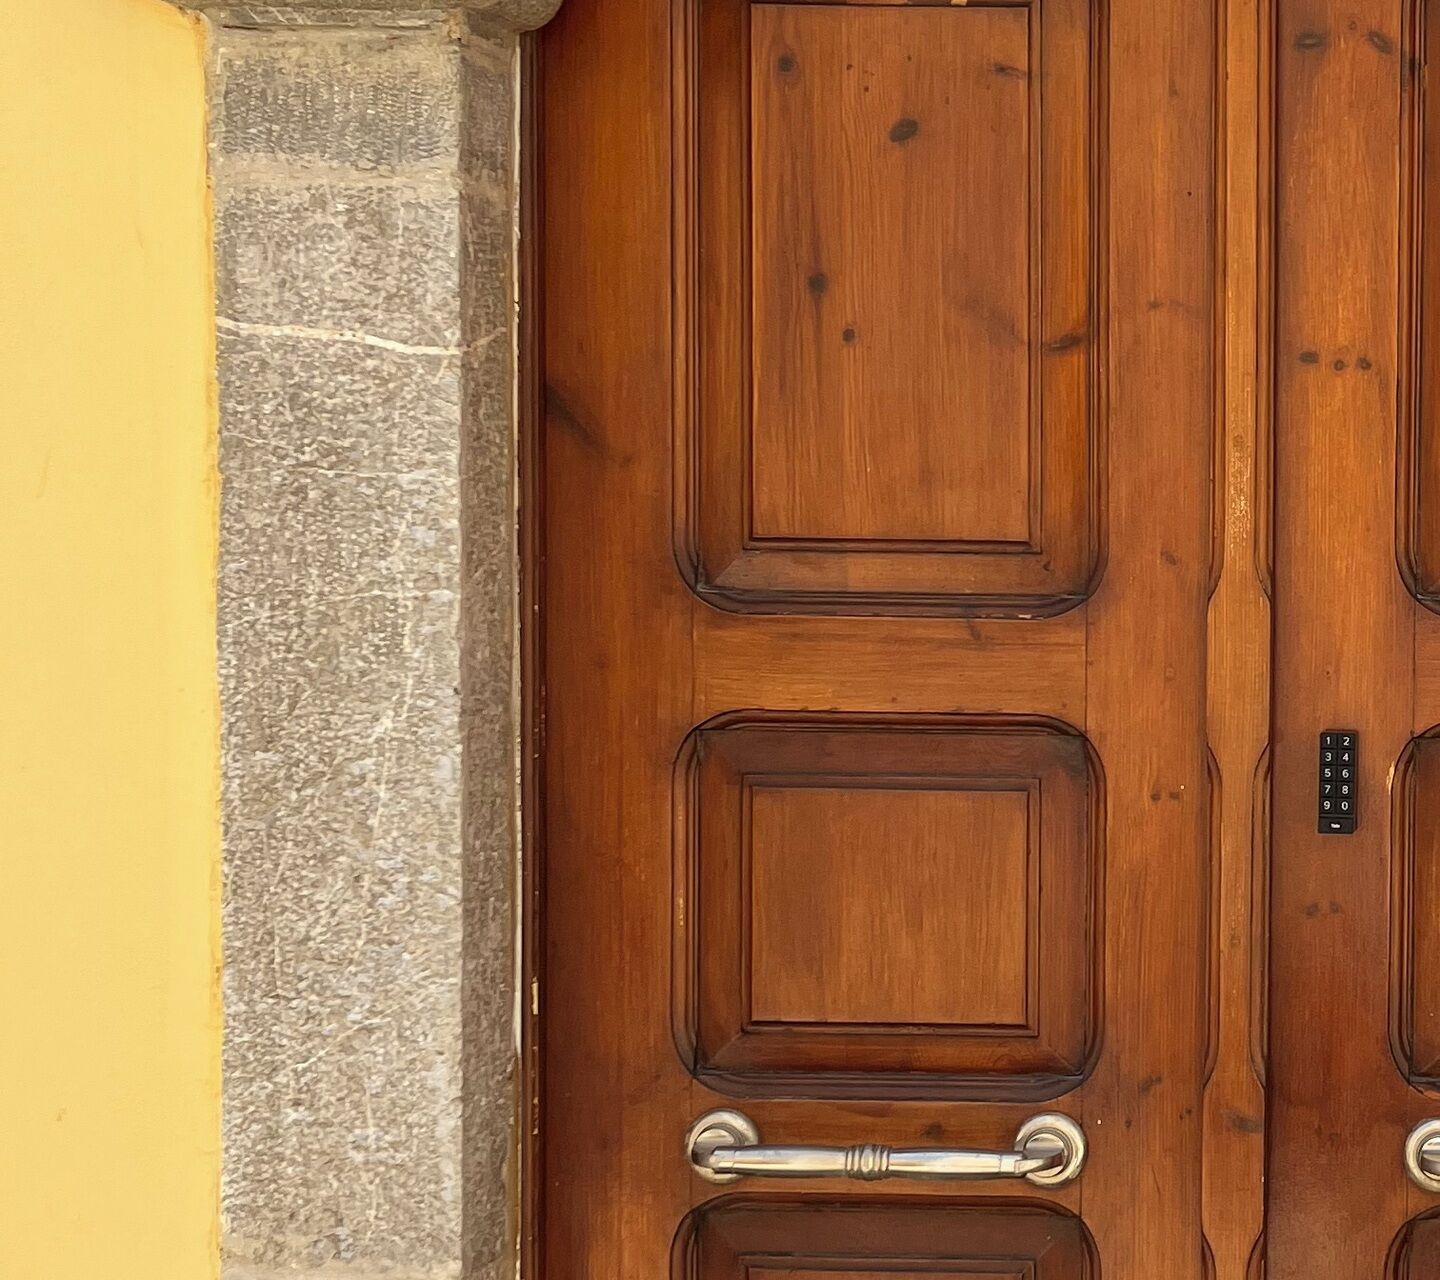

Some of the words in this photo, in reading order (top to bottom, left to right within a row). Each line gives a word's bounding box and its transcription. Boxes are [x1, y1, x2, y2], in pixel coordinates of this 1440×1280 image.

[1343, 736, 1350, 746] 2
[1325, 752, 1332, 762] 3
[1342, 752, 1349, 762] 4
[1324, 768, 1331, 778] 5
[1342, 769, 1349, 778] 6
[1324, 784, 1331, 794] 7
[1341, 785, 1349, 795] 8
[1323, 800, 1331, 810] 9
[1341, 801, 1349, 811] 0
